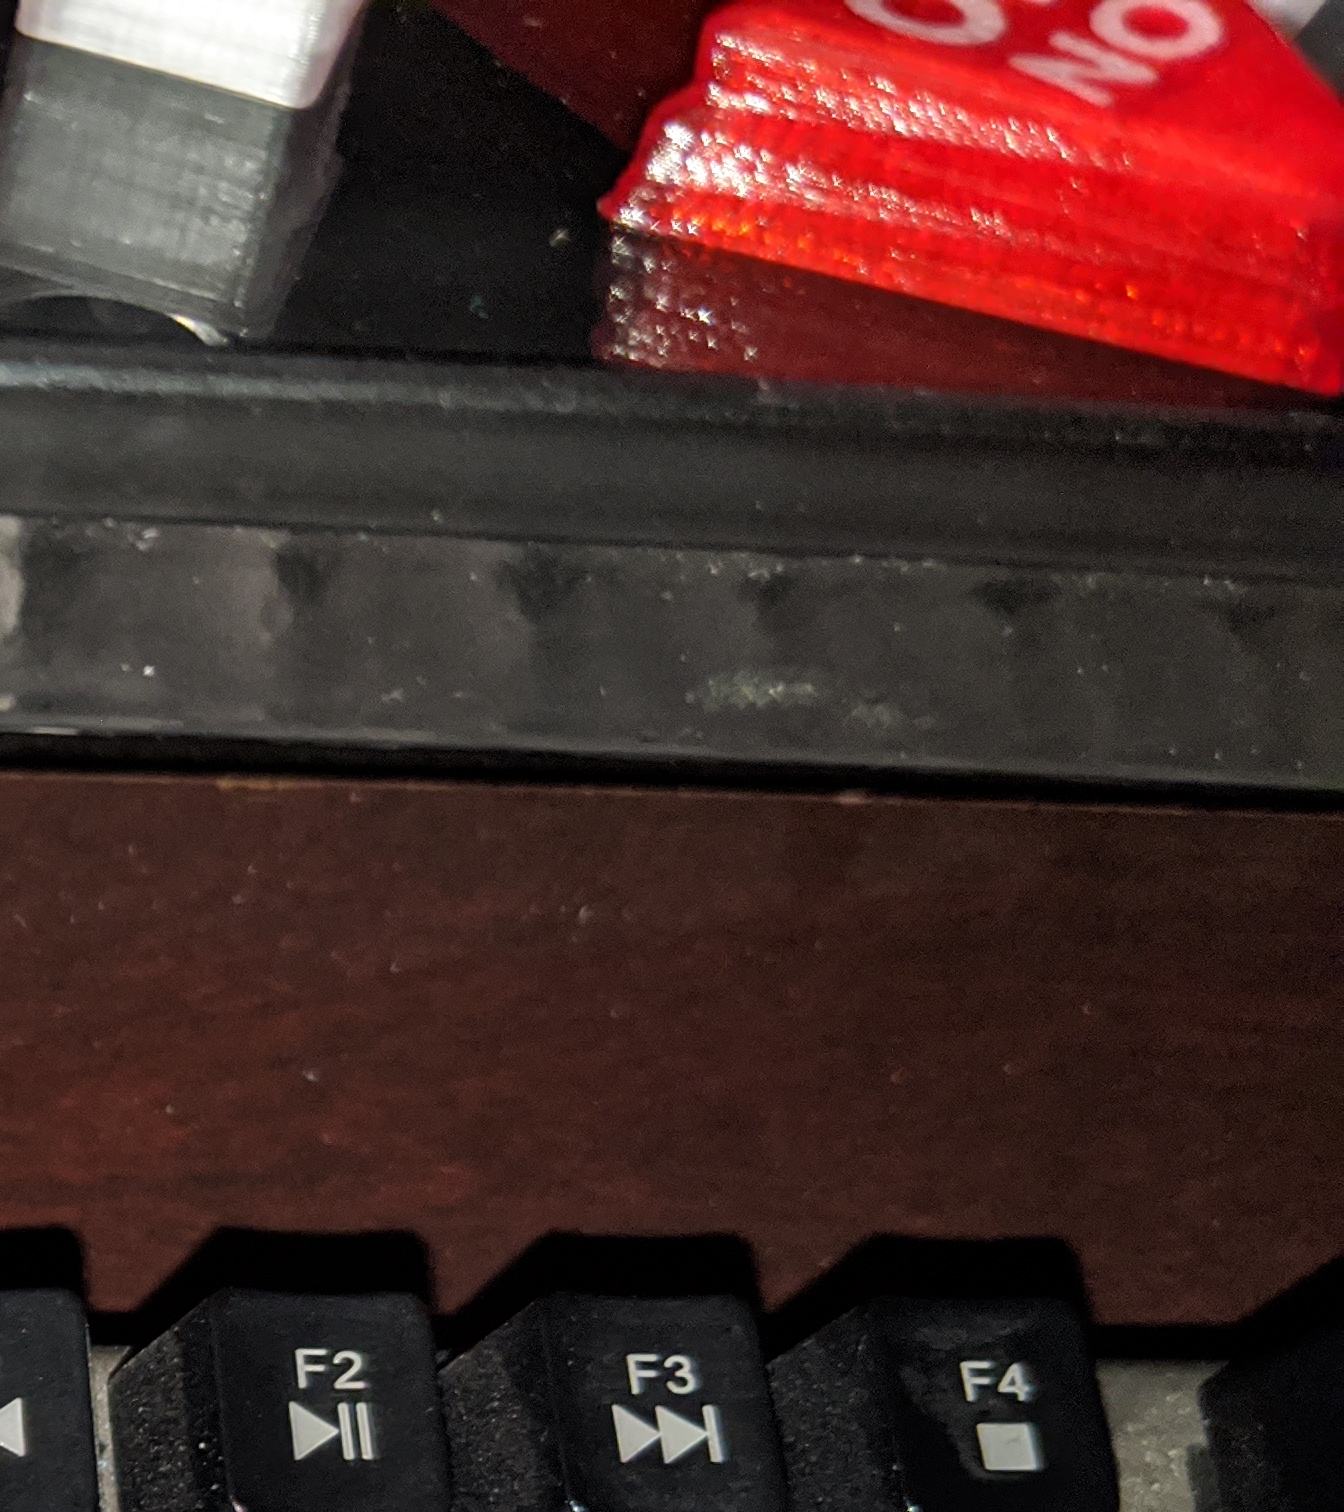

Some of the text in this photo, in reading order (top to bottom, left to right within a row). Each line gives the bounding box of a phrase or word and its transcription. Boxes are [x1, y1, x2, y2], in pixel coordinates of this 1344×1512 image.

[294, 1347, 369, 1391] F2
[625, 1352, 700, 1397] F3
[959, 1359, 1035, 1403] F4
